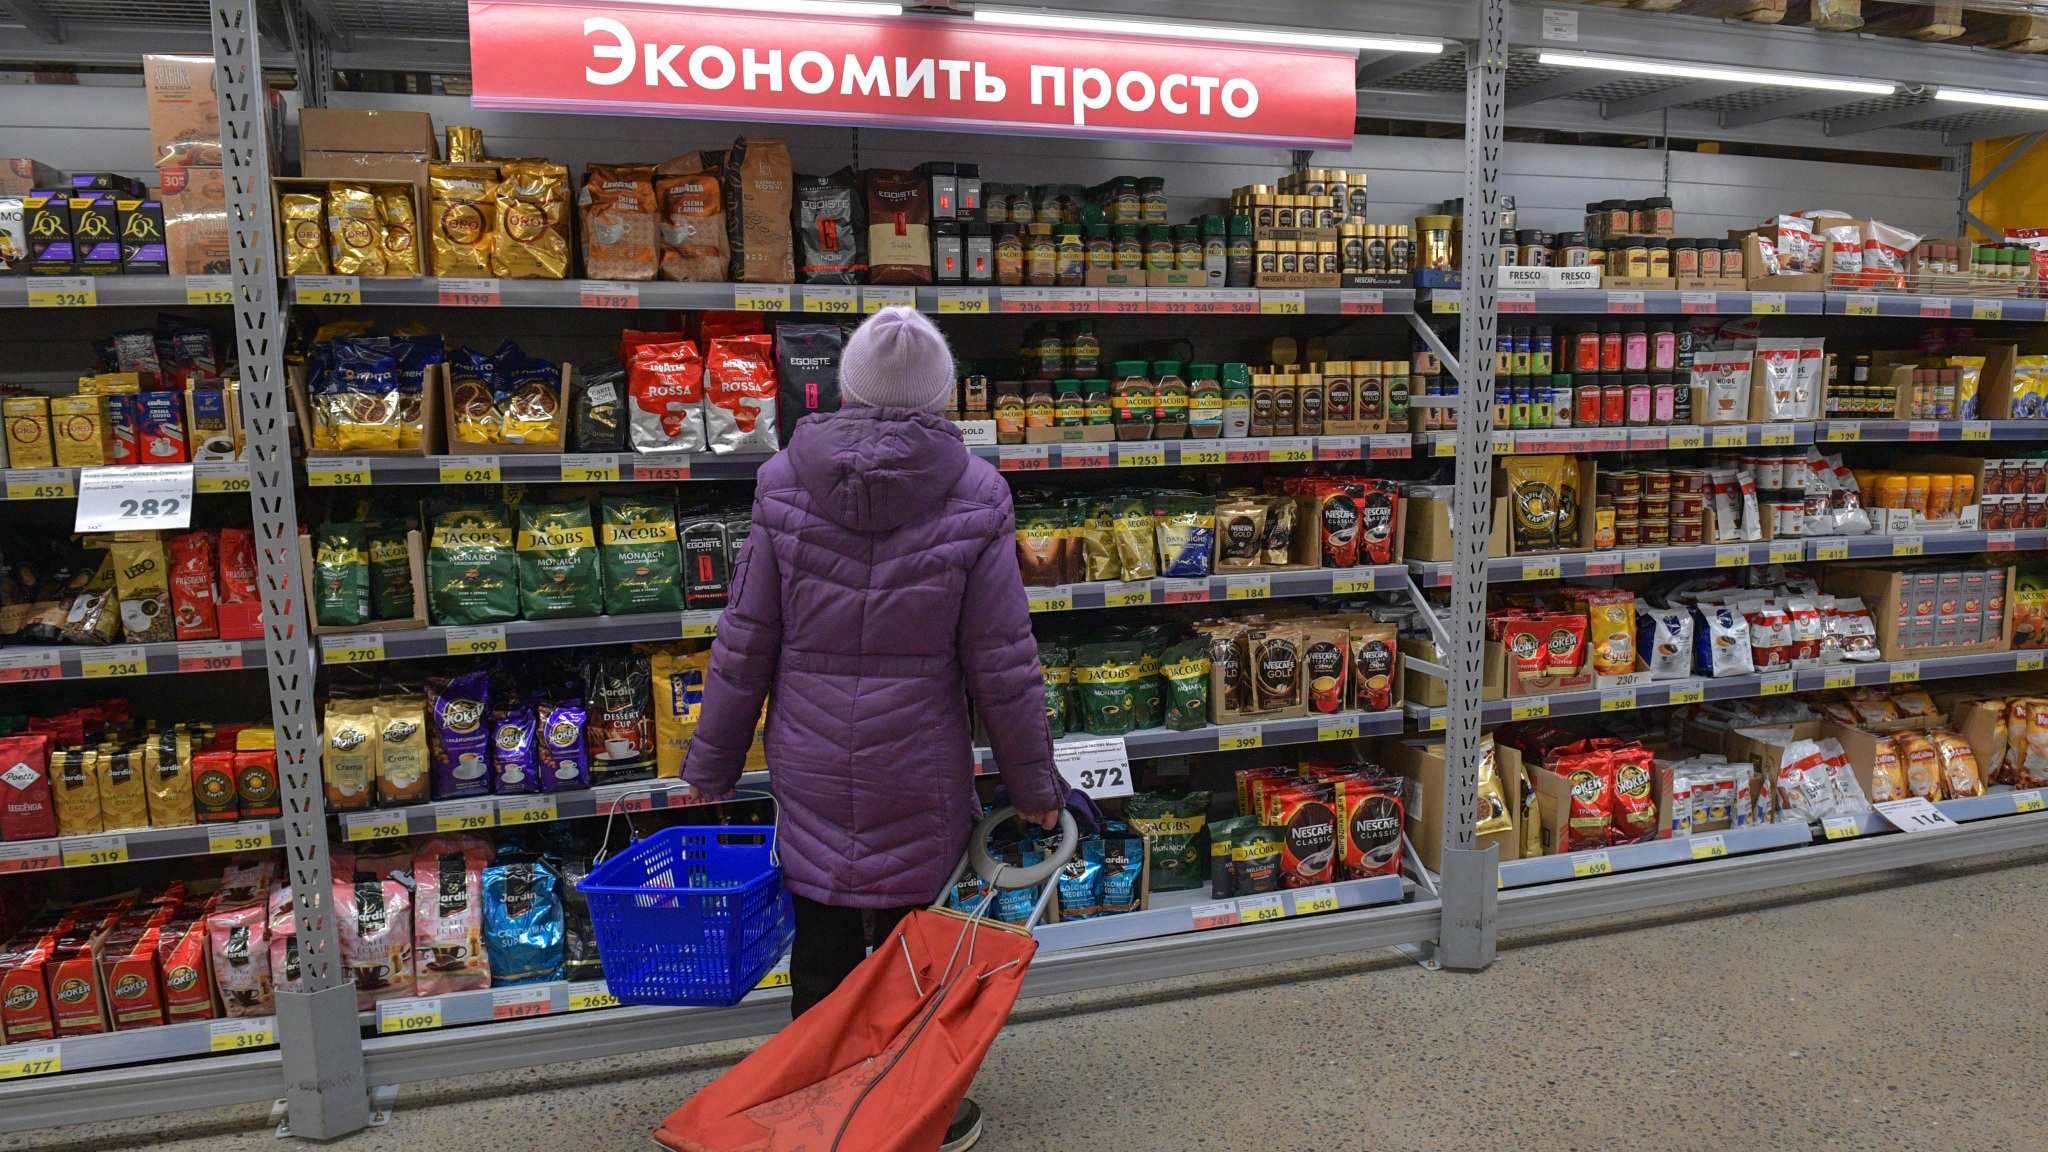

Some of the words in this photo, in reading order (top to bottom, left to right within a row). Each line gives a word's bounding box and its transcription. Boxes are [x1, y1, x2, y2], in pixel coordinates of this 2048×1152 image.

[584, 17, 1006, 103] Экономить
[1031, 65, 1259, 126] просто
[879, 190, 917, 198] EGOISTE
[802, 200, 848, 210] EGOISTE
[449, 219, 478, 231] ORO
[510, 216, 540, 227] ORO
[1510, 271, 1541, 280] FRESCO
[1561, 272, 1590, 280] FRESCO
[56, 294, 86, 306] 324
[205, 293, 232, 303] 152
[322, 293, 350, 304] 472
[454, 295, 489, 305] 1199
[595, 298, 628, 307] 1782
[751, 300, 782, 310] 1309
[818, 302, 849, 312] 1399
[959, 301, 981, 311] 399
[1020, 303, 1041, 312] 236
[1069, 303, 1090, 312] 322
[1118, 303, 1138, 312] 322
[1166, 304, 1186, 312] 322
[1232, 304, 1251, 312] 349
[1280, 304, 1298, 313] 124
[1357, 305, 1375, 313] 275
[1771, 305, 1780, 313] 24
[1985, 311, 1997, 319] 196
[790, 357, 830, 366] EGOISTE
[649, 385, 692, 396] ROSSA
[721, 382, 762, 392] ROSSA
[1683, 439, 1698, 447] 999
[1727, 438, 1741, 446] 116
[1775, 436, 1790, 444] 222
[1199, 453, 1219, 462] 322
[1242, 452, 1262, 461] 621
[1287, 451, 1306, 460] 236
[1019, 460, 1040, 469] 349
[1080, 457, 1101, 466] 236
[1132, 456, 1158, 466] 1253
[334, 474, 361, 484] 354
[464, 471, 491, 481] 624
[585, 470, 609, 480] 791
[650, 469, 680, 479] 1453
[222, 480, 249, 490] 209
[35, 487, 64, 497] 452
[120, 500, 179, 517] 282
[442, 532, 500, 544] JACOBS
[611, 527, 666, 541] JACOBS
[529, 532, 583, 547] JACOBS
[450, 554, 496, 562] MONARCH
[619, 551, 664, 560] MONARCH
[1783, 553, 1797, 561] 144
[538, 557, 580, 566] MONARCH
[1734, 557, 1744, 565] 62
[124, 559, 155, 580] LEBO
[1538, 568, 1555, 577] 444
[1640, 563, 1655, 572] 149
[176, 576, 206, 586] PRÄSIDENT
[1350, 582, 1368, 591] 179
[1182, 592, 1202, 601] 479
[1245, 589, 1263, 597] 184
[1124, 594, 1144, 604] 299
[1045, 601, 1065, 610] 189
[470, 642, 497, 652] 999
[348, 650, 375, 661] 270
[108, 664, 137, 675] 234
[204, 659, 231, 670] 309
[22, 668, 49, 679] 270
[1088, 669, 1130, 680] JACOBS
[1267, 668, 1293, 678] GOLD
[1902, 672, 1915, 680] 199
[1617, 675, 1632, 685] 230
[600, 687, 635, 697] Jardin
[1774, 684, 1788, 692] 147
[1684, 694, 1698, 702] 399
[1615, 701, 1630, 709] 549
[442, 705, 485, 728] ЖОКЕЙ
[604, 711, 639, 721] DESSERT
[1527, 708, 1543, 716] 229
[613, 720, 631, 728] CUP
[383, 724, 416, 742] ЖОКЕЙ
[549, 726, 579, 742] ЖОКЕЙ
[1335, 729, 1353, 738] 179
[331, 734, 365, 749] ЖОКЕЙ
[496, 732, 526, 747] ЖОКЕЙ
[1236, 738, 1255, 748] 399
[388, 754, 415, 762] Crema
[108, 768, 133, 776] Jardin
[156, 764, 182, 772] Jardin
[336, 763, 363, 771] Crema
[6, 772, 33, 781] Poetti
[61, 774, 86, 782] Jardin
[1080, 768, 1124, 789] 372
[2027, 802, 2040, 810] 599
[523, 810, 548, 821] 436
[1912, 813, 1944, 825] 114
[461, 817, 486, 828] 789
[1144, 820, 1190, 832] JACOBS
[373, 826, 399, 836] 296
[1360, 829, 1397, 839] CLASSIC
[1840, 828, 1854, 837] 114
[235, 838, 262, 849] 359
[1296, 834, 1331, 847] CLASSIC
[1244, 844, 1274, 859] JACOBS
[1712, 847, 1722, 856] 46
[90, 852, 118, 863] 319
[20, 859, 48, 870] 477
[1246, 863, 1275, 873] MILLICANO
[1590, 864, 1605, 873] 659
[434, 891, 472, 902] Jardin
[500, 891, 536, 903] Jardin
[1313, 900, 1331, 910] 649
[1259, 909, 1277, 919] 634
[1211, 916, 1230, 926] 749
[166, 970, 198, 987] ЖОКЕЙ
[57, 984, 91, 1000] ЖОКЕЙ
[114, 979, 148, 996] ЖОКЕЙ
[4, 990, 39, 1008] ЖОКЕЙ
[584, 996, 617, 1008] 2659
[508, 1004, 540, 1015] 1472
[399, 1016, 432, 1028] 1099
[237, 1033, 264, 1046] 319
[22, 1061, 51, 1074] 477
